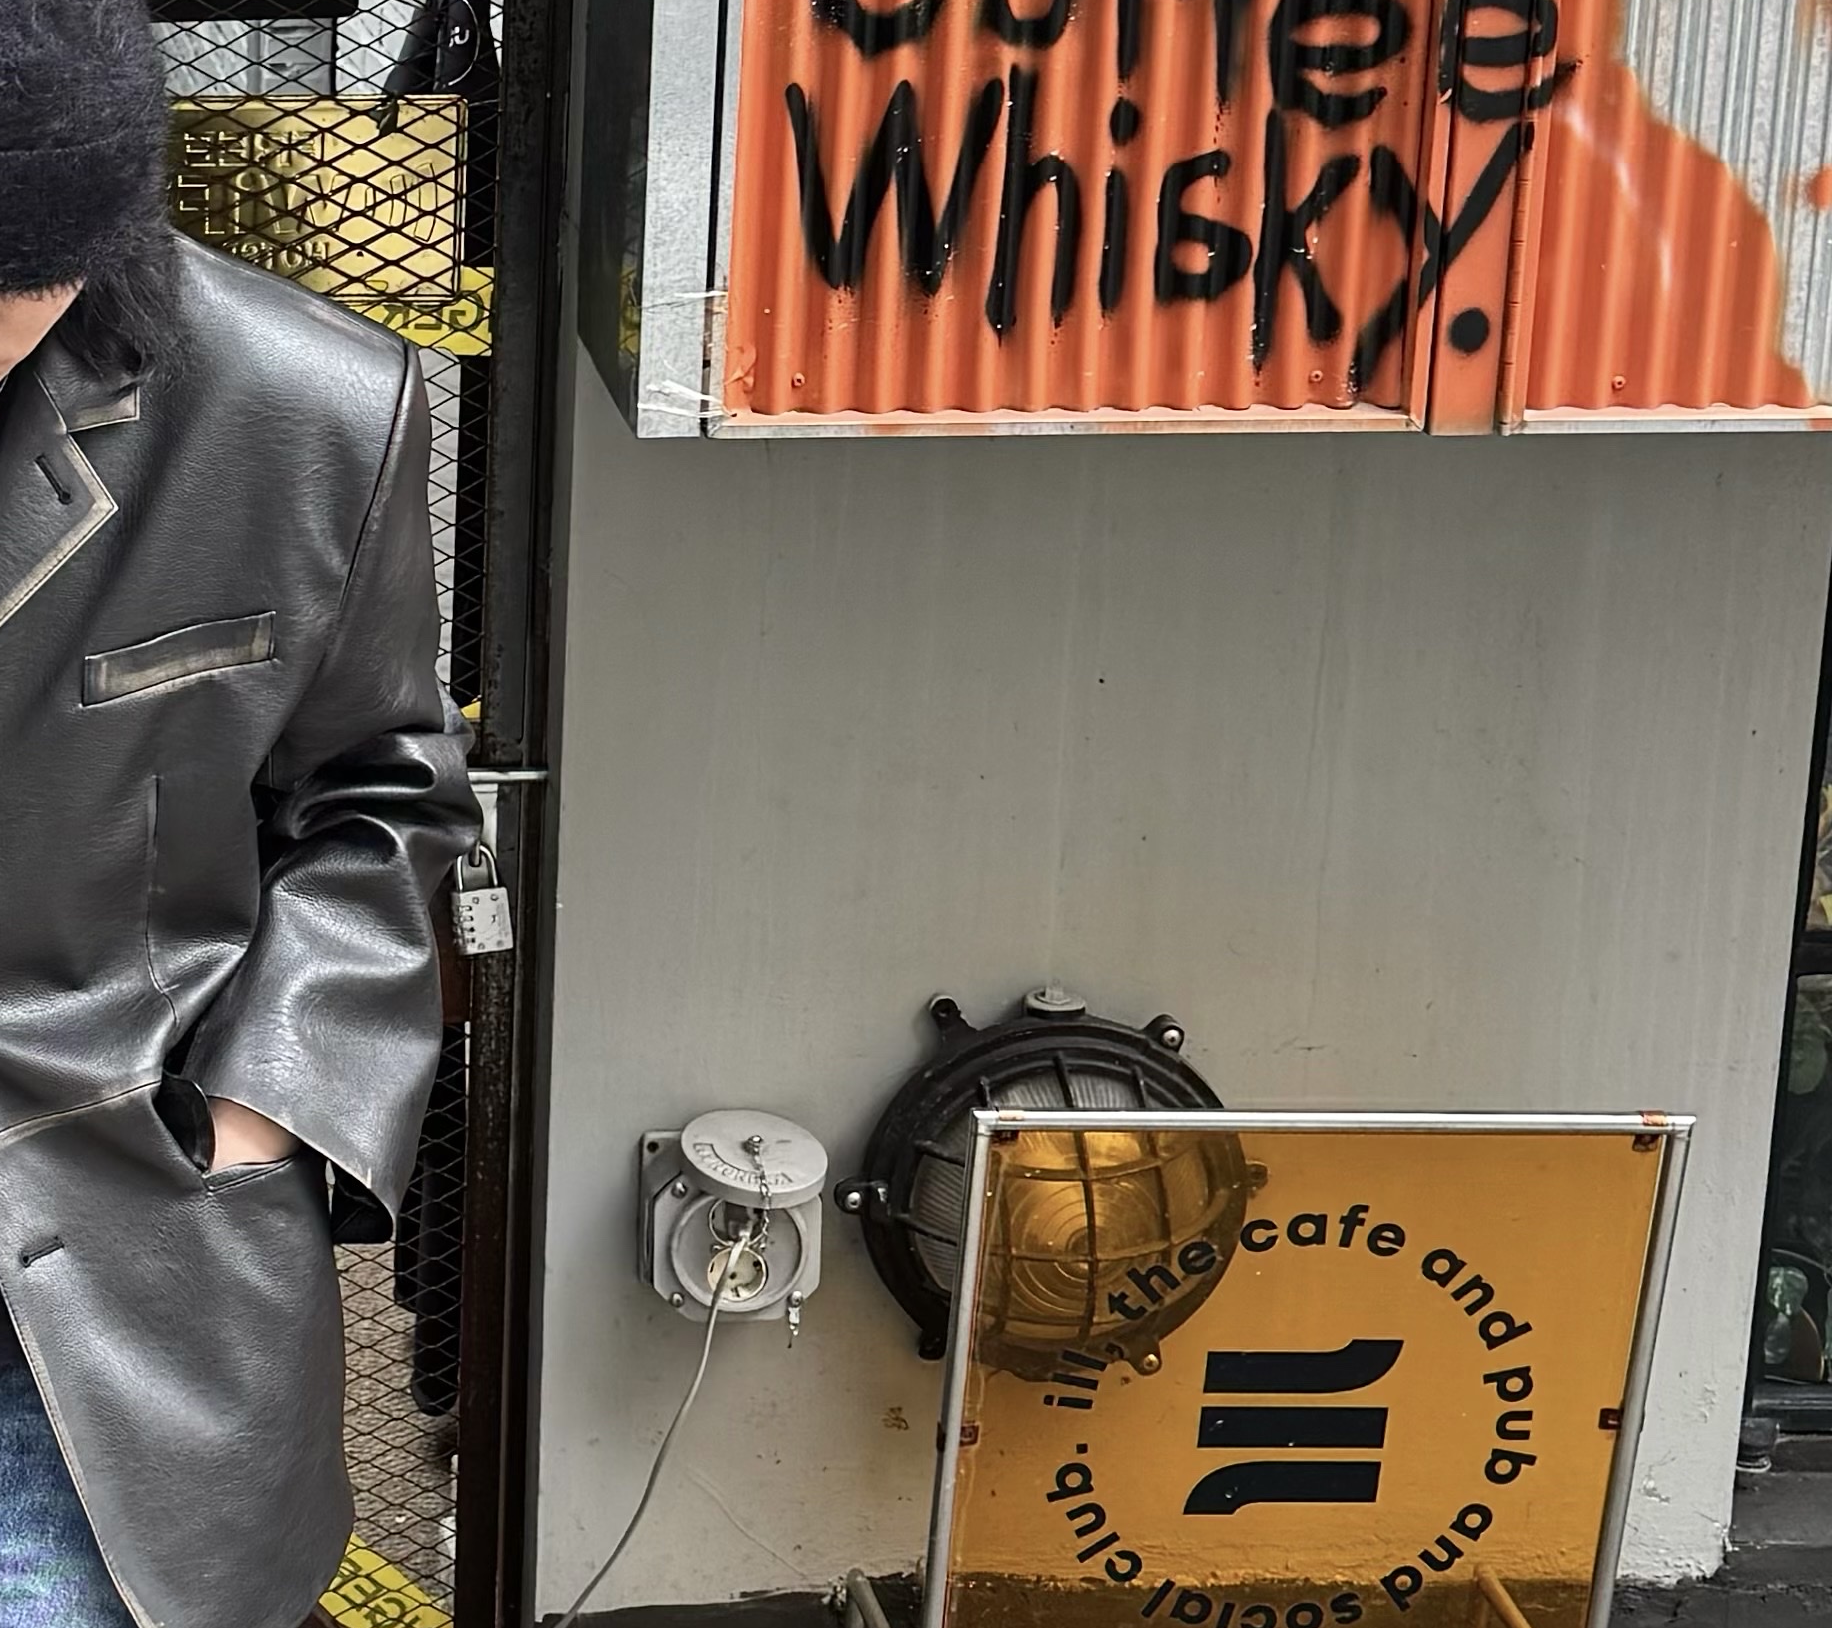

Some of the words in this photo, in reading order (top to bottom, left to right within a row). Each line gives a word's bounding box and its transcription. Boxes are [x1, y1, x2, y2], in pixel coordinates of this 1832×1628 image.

[1108, 1241, 1218, 1321] the
[1239, 1204, 1407, 1257] cafe
[1421, 1248, 1533, 1350] and
[1482, 1365, 1538, 1485] pub
[1045, 1443, 1143, 1583] club.
[1379, 1502, 1494, 1611] and
